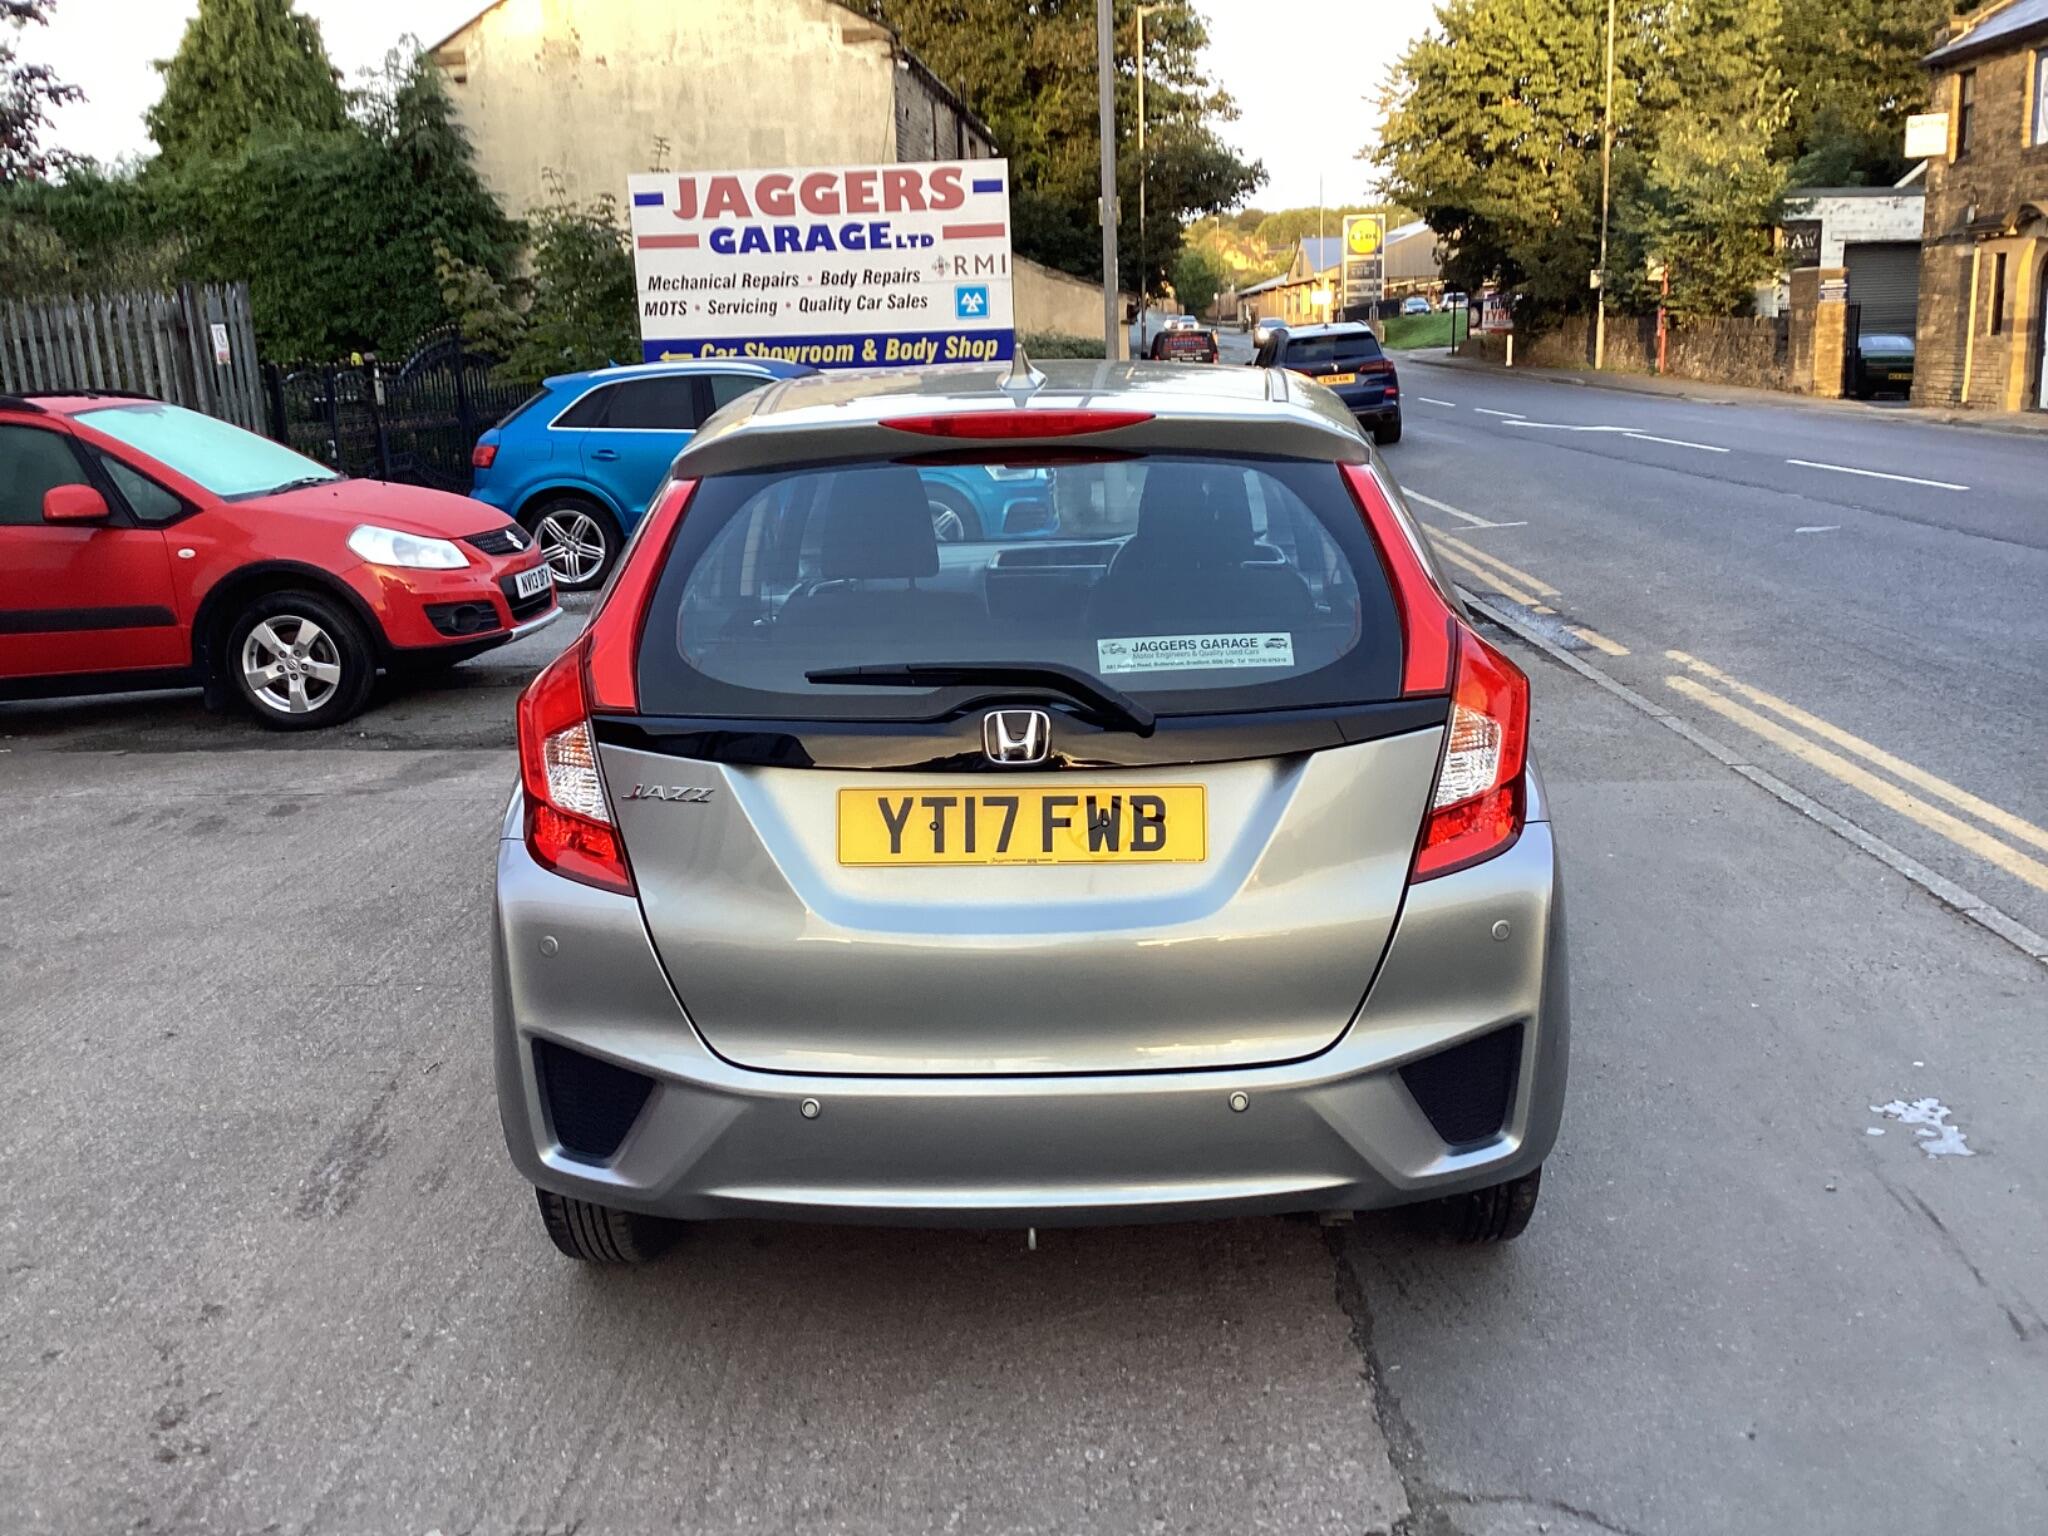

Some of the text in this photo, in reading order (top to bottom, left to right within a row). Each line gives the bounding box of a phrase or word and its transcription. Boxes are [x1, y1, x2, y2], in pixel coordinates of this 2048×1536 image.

[673, 168, 966, 220] JAGGERS
[709, 222, 935, 255] GARAGE LTD
[954, 253, 1006, 275] RMI
[648, 267, 921, 291] Mechanical Repairs Body Repairs
[644, 293, 929, 317] MOTS Servicing Quality Car Sales
[700, 335, 998, 364] Car Showroom & Body Shop
[1131, 637, 1259, 653] JAGGERS GARAGE
[1156, 650, 1191, 660] Engineers
[1199, 649, 1224, 657] Quality
[1226, 648, 1243, 656] Used
[621, 783, 715, 803] JAZZ
[878, 794, 1168, 854] YT17 FWB
